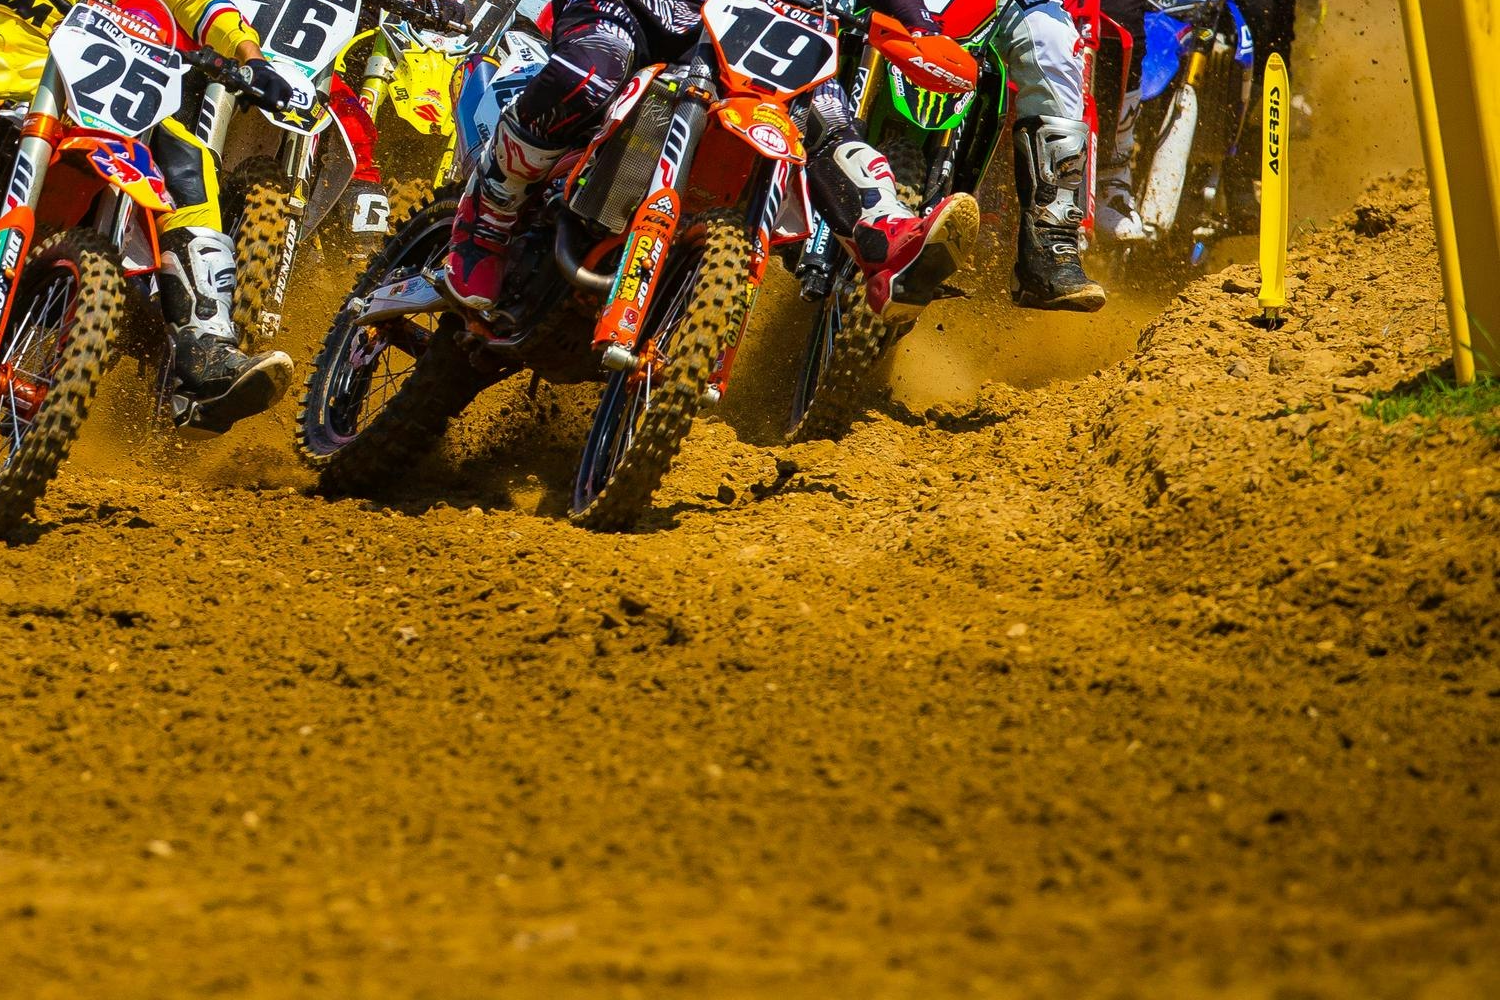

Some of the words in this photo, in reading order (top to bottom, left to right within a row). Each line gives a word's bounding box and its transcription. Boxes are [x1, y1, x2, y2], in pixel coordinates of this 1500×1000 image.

[93, 3, 160, 41] RENTHAL
[94, 18, 130, 46] LUCA
[130, 42, 152, 59] OIL
[717, 4, 835, 91] 19
[789, 9, 811, 25] OIL
[71, 43, 172, 132] 25
[1268, 86, 1281, 176] ACERBIS
[637, 237, 664, 310] DUOP
